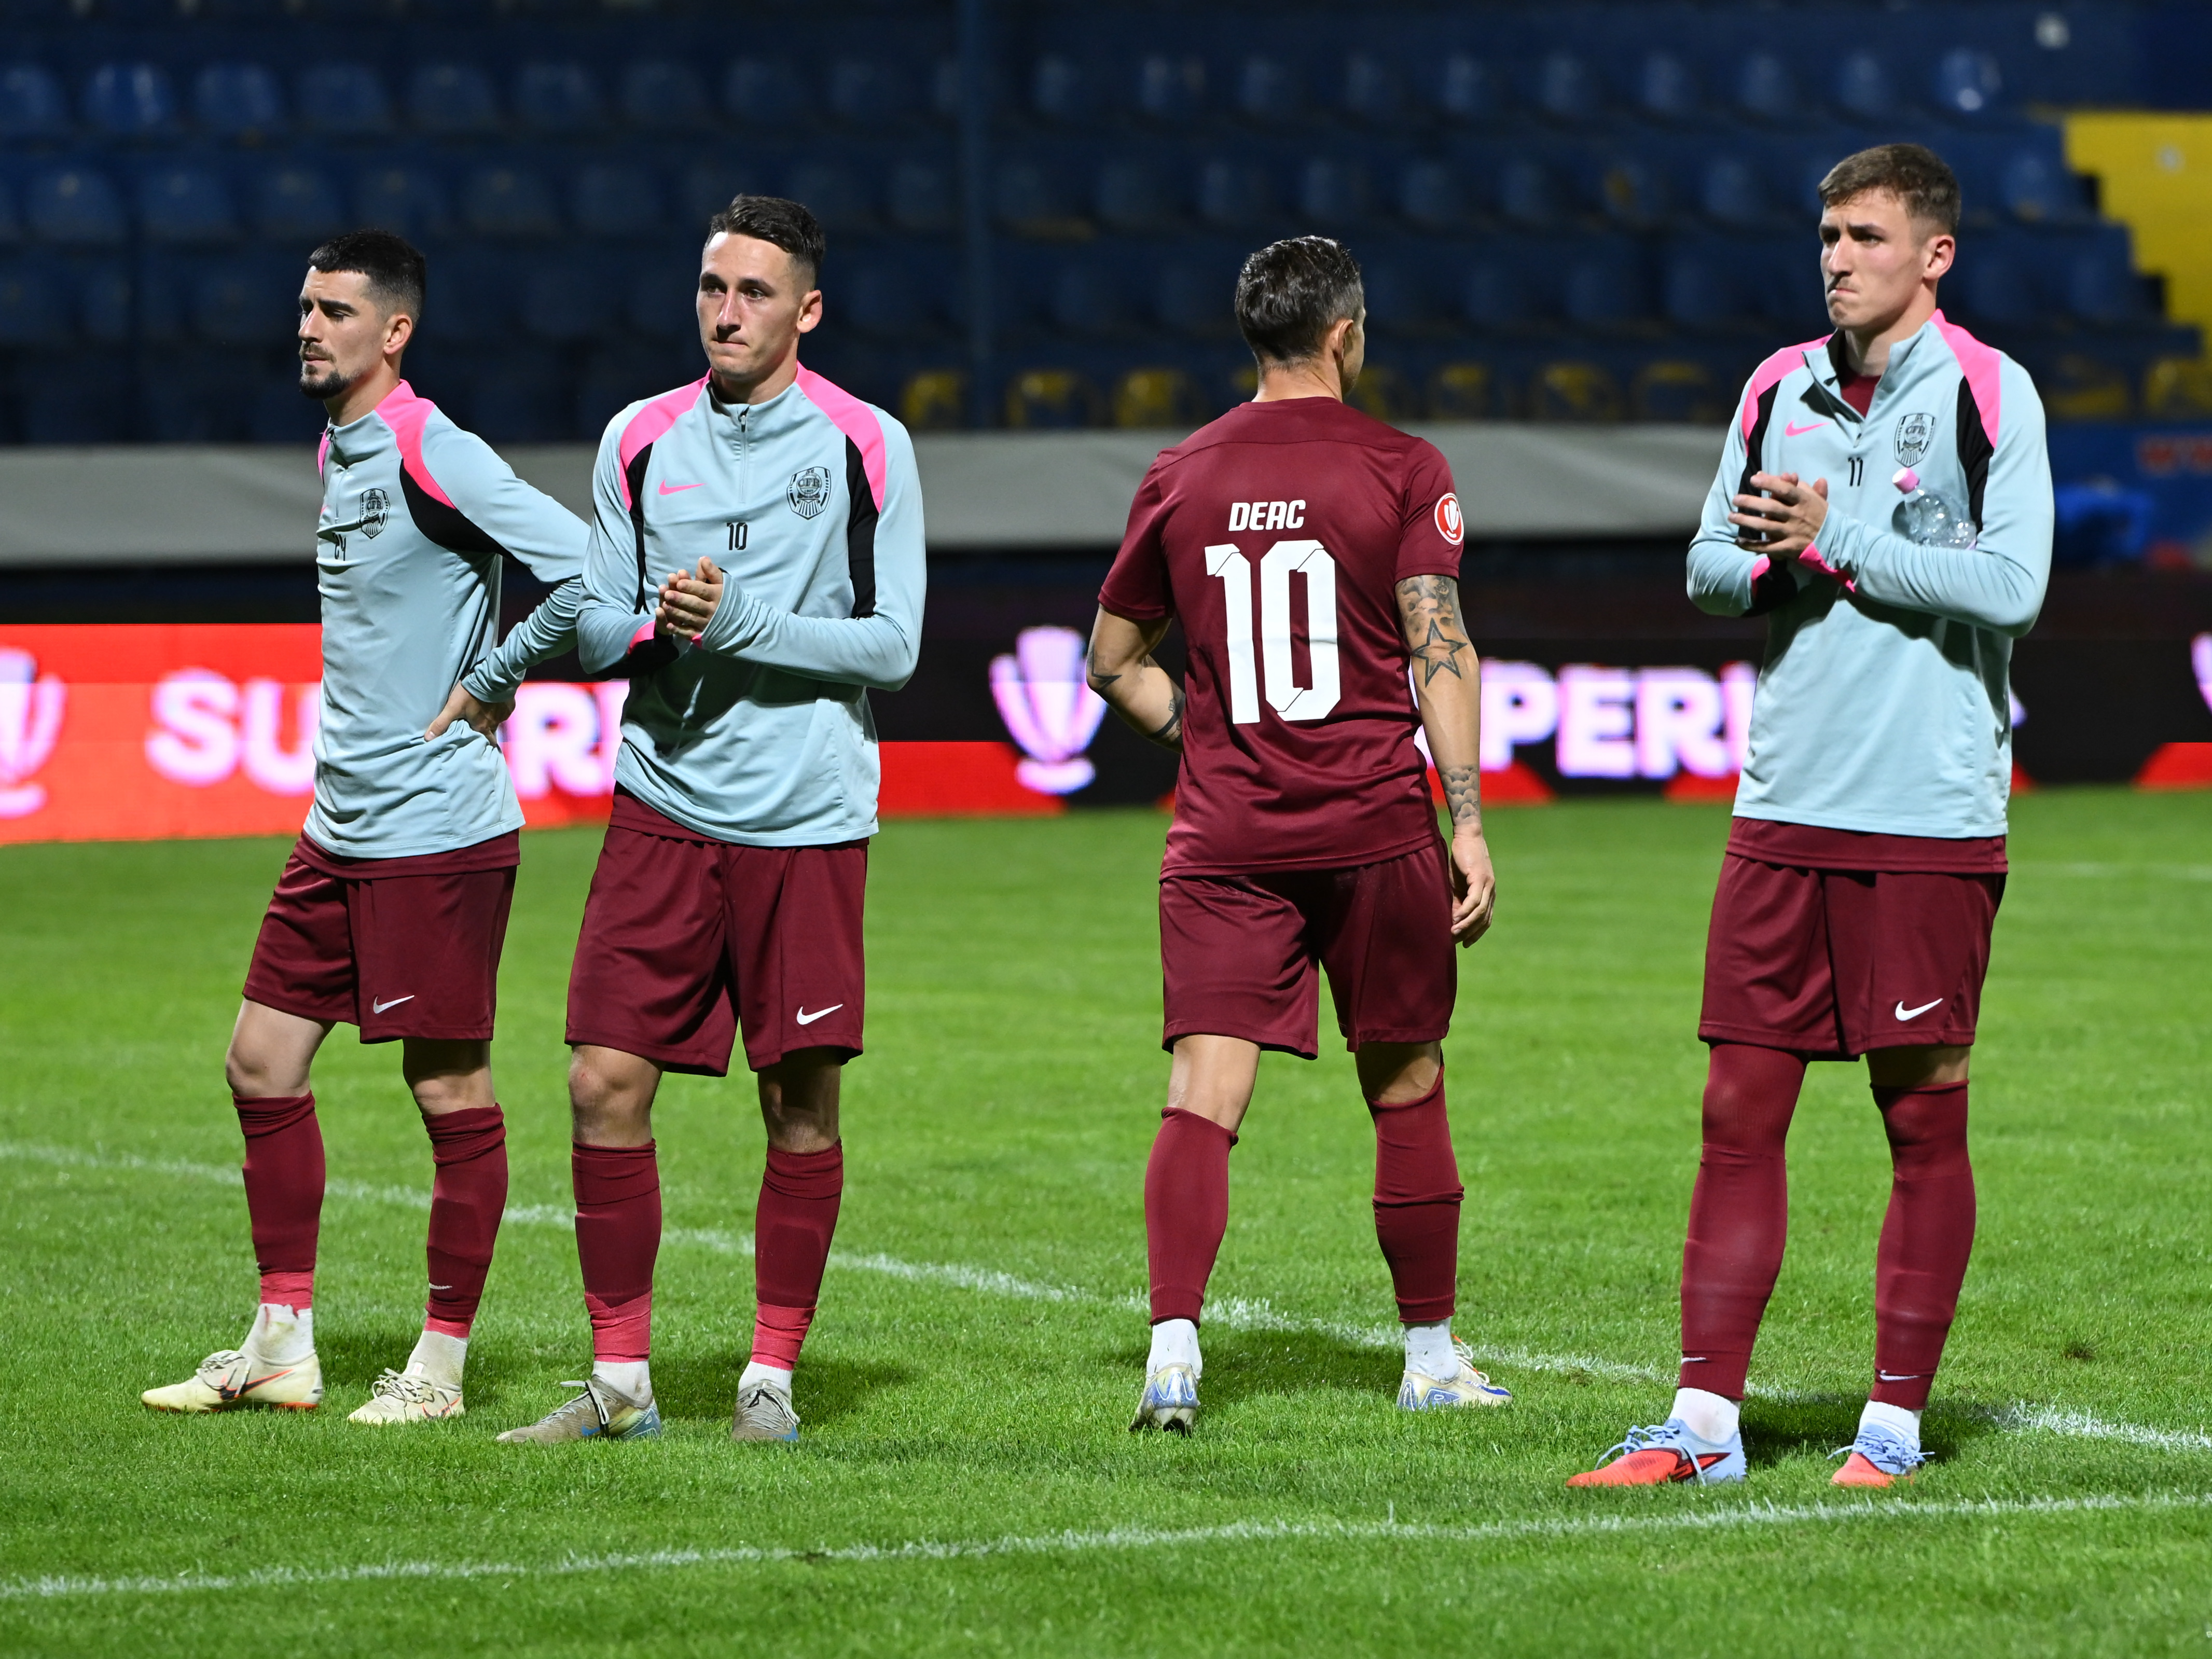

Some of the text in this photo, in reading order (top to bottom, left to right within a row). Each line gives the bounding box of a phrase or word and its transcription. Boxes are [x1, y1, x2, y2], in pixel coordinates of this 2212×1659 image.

[798, 477, 821, 488] CFR
[1848, 457, 1863, 487] 11
[1228, 499, 1306, 532] DEAC
[727, 522, 748, 551] 10
[1204, 539, 1341, 724] 10
